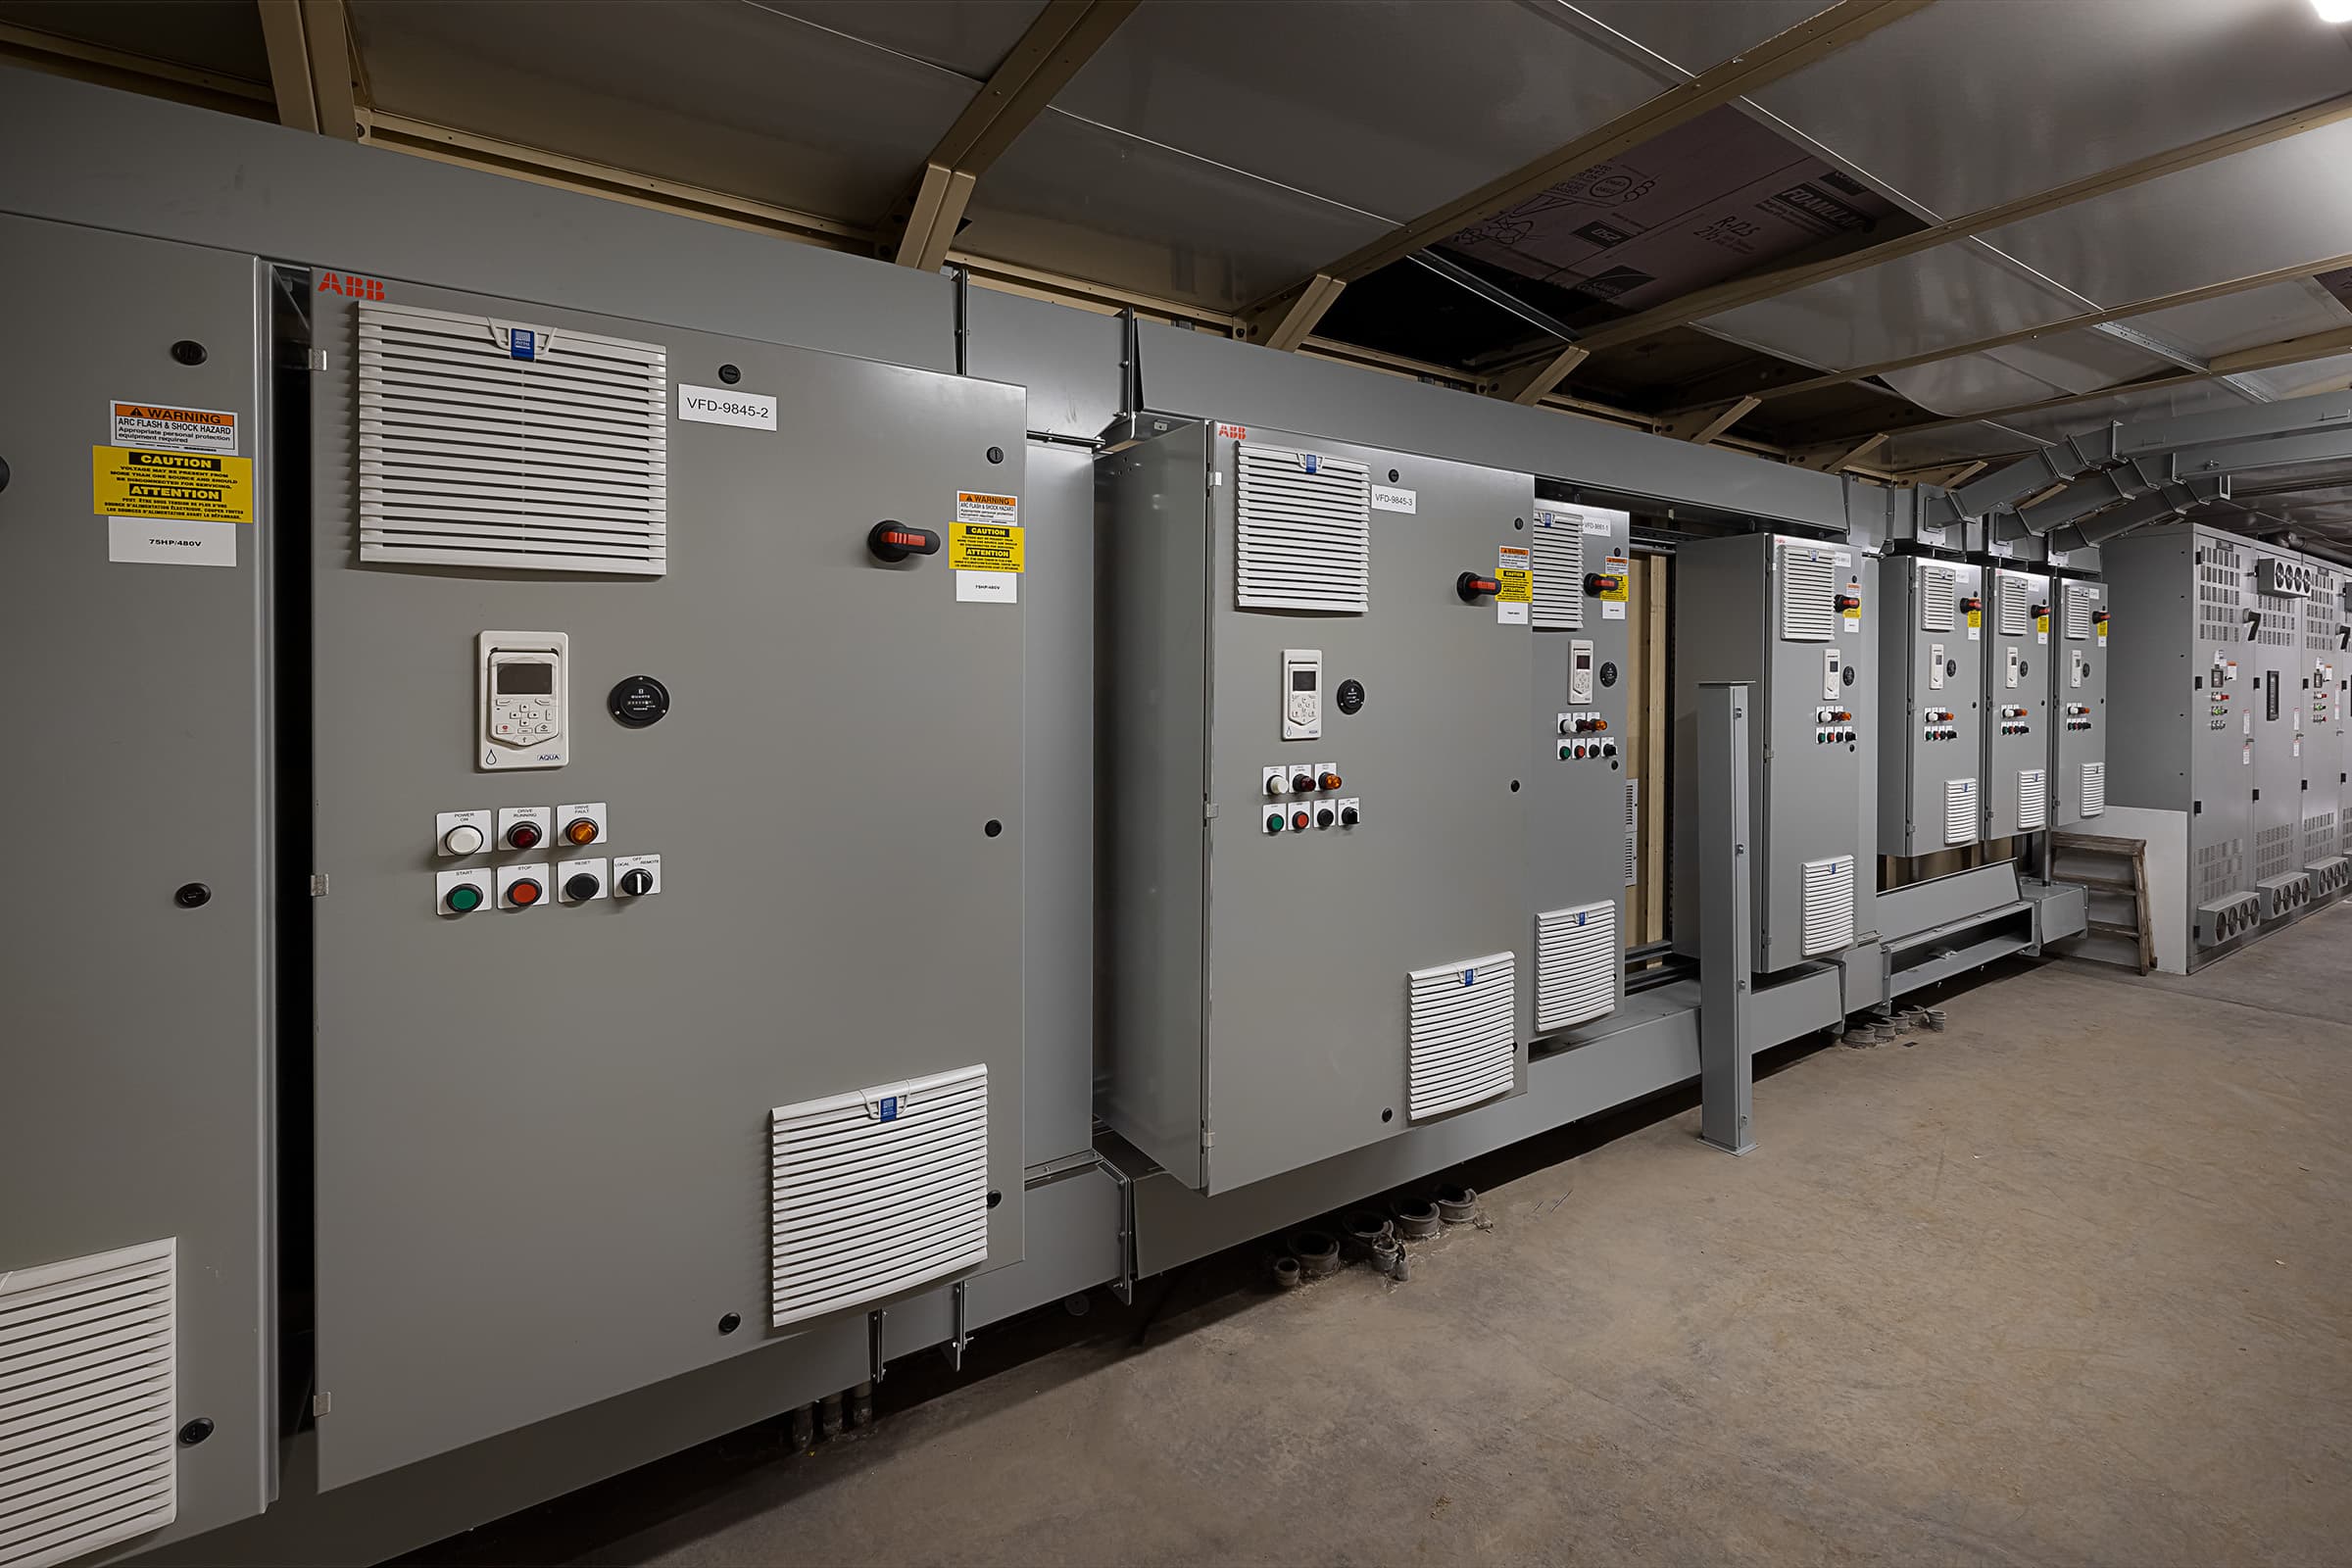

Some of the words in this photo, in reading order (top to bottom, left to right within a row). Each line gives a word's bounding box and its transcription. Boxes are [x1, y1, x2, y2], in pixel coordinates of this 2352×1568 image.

[318, 271, 385, 301] ABB
[686, 396, 769, 419] VFD-9845-2
[148, 408, 221, 423] WARNING
[118, 417, 135, 426] ARC
[136, 418, 163, 428] FLASH
[172, 421, 198, 431] SHOCK
[200, 424, 231, 435] HAZARD
[1219, 424, 1247, 440] ABB
[140, 455, 212, 468] CAUTION
[130, 485, 220, 500] ATTENTION
[975, 495, 1010, 505] WARNING
[1374, 493, 1414, 507] VFD-9845-3
[971, 527, 1005, 536] CAUTION
[149, 539, 202, 547] 75HP/480V
[966, 549, 1009, 558] ATTENTION
